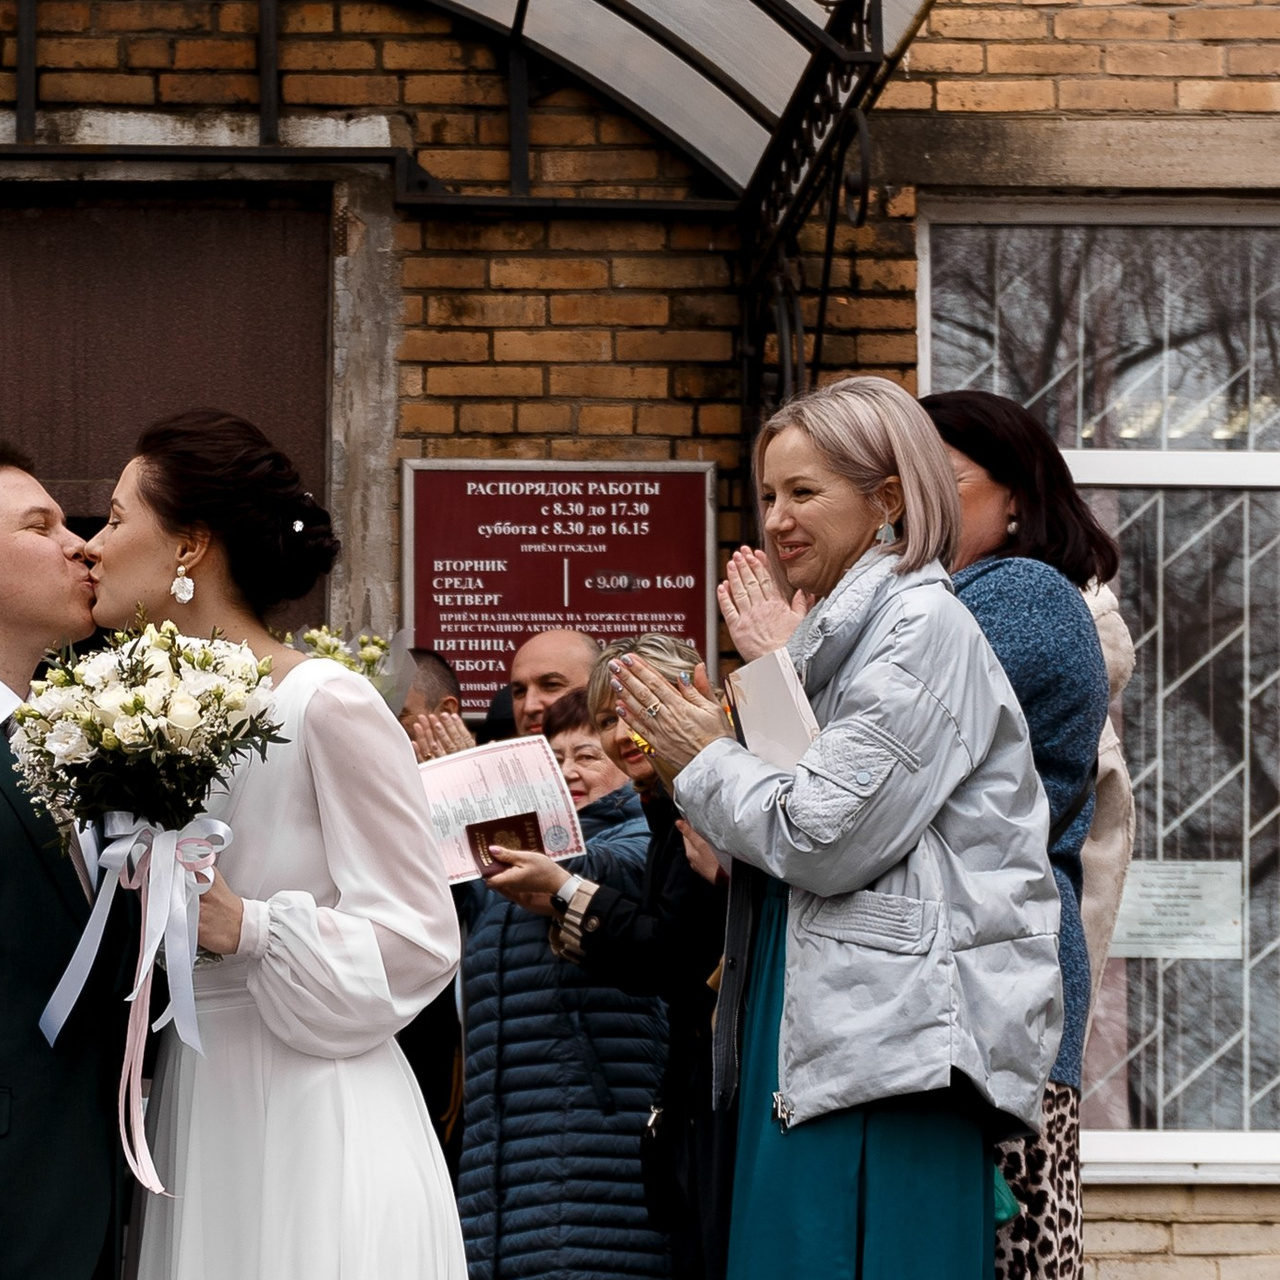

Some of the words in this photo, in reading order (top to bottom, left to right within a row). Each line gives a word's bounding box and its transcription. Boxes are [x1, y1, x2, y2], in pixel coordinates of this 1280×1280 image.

[467, 482, 583, 496] РАСПОРЯДОК
[588, 482, 661, 495] РАБОТЫ
[541, 506, 550, 515] с
[553, 503, 584, 515] 8.30
[587, 506, 606, 517] до
[611, 503, 650, 515] 17.30
[478, 522, 537, 538] суббота
[541, 525, 550, 535] с
[553, 522, 584, 535] 8.30
[587, 525, 606, 536] до
[611, 522, 650, 535] 16.15
[520, 543, 556, 552] ПРИЁМ
[559, 544, 606, 553] ГРАЖДАН
[433, 560, 508, 572] ВТОРНИК
[432, 577, 484, 590] СРЕДА
[597, 575, 628, 588] 9.00
[655, 575, 695, 588] 16.00
[432, 594, 503, 606] ЧЕТВЕРГ
[440, 612, 478, 621] ПРИЁМ
[481, 613, 563, 621] НАЗНАЧЕННЫХ
[566, 613, 581, 621] НА
[584, 613, 686, 621] ТОРЖЕСТВЕННУЮ
[440, 624, 524, 633] РЕГИСТРАЦИЮ
[575, 624, 637, 633] РОЖДЕНИИ
[650, 624, 685, 632] БРАКЕ
[433, 639, 516, 652] ПЯТНИЦА
